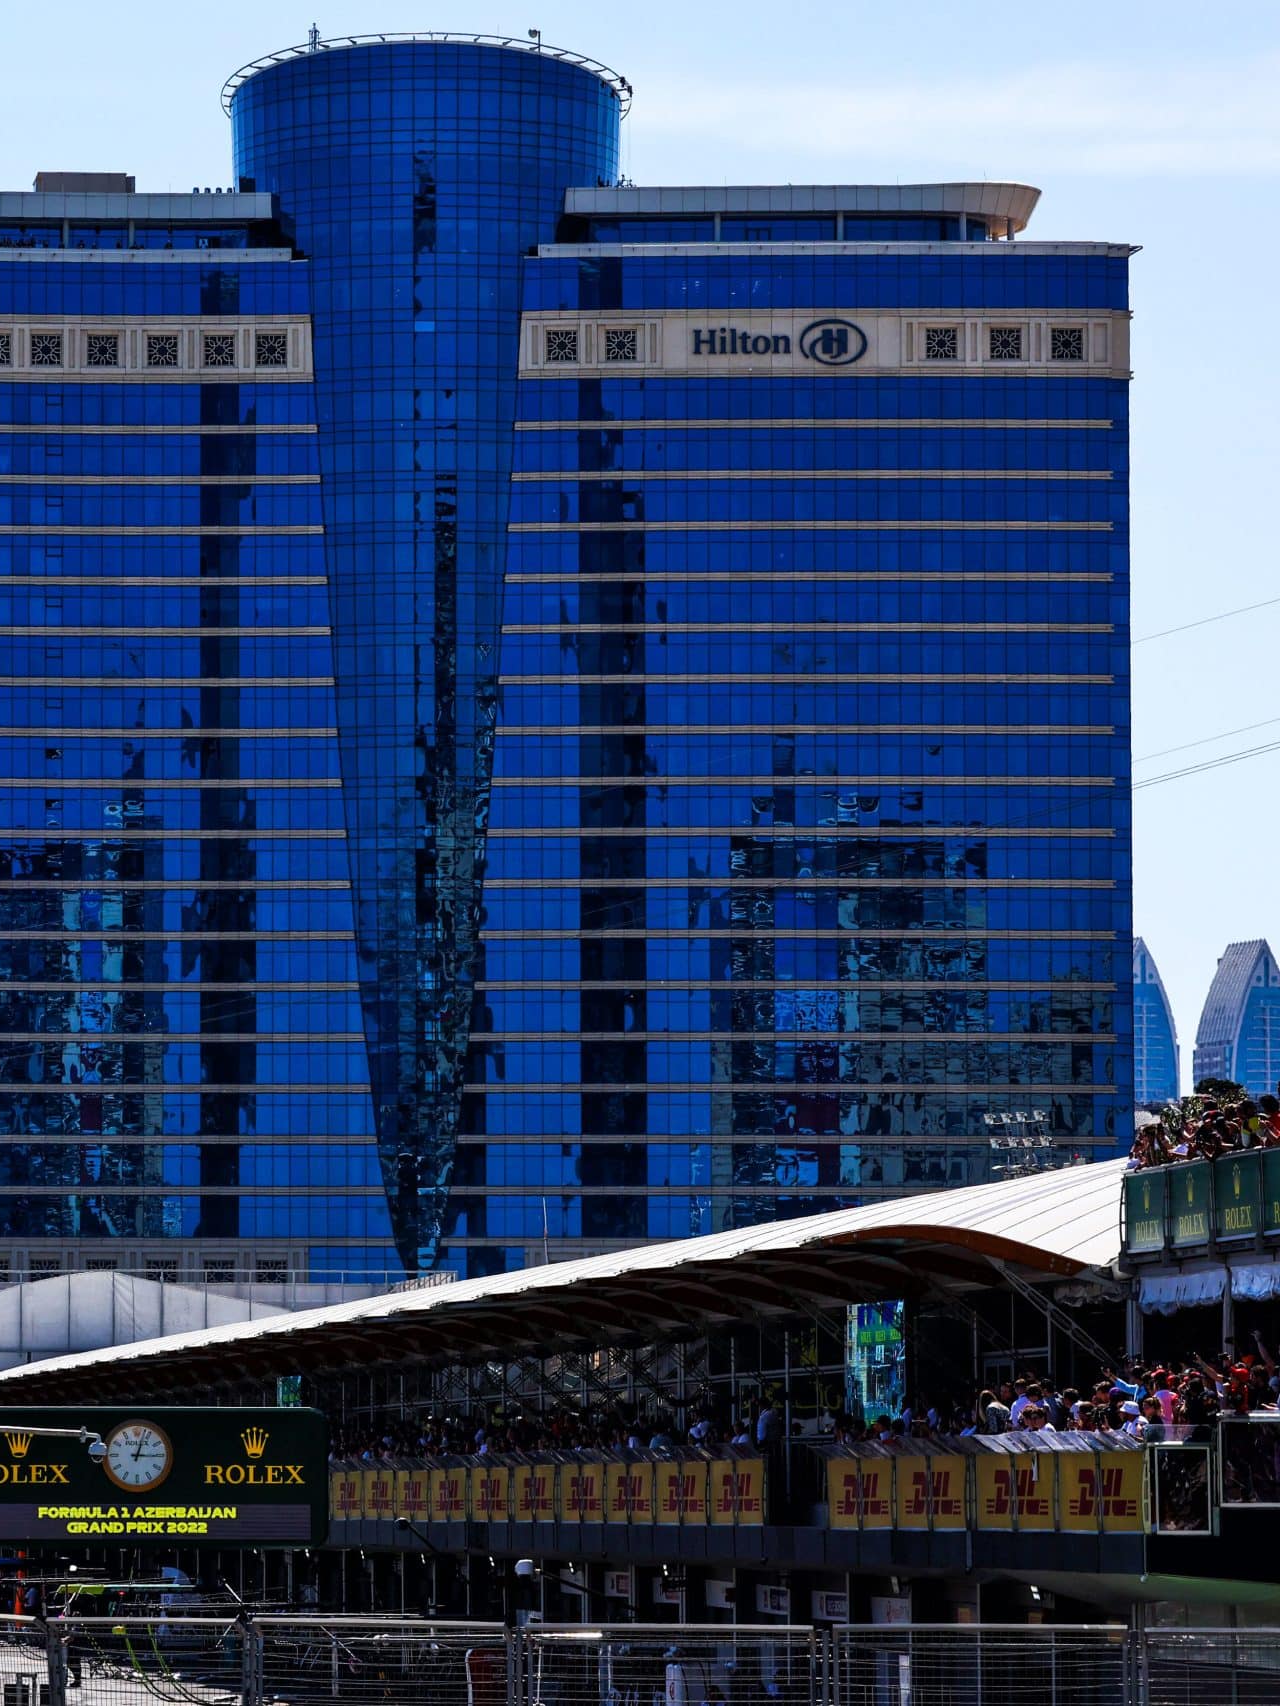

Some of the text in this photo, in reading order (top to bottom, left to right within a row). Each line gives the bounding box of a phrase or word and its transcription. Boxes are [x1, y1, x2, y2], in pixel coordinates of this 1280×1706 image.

[693, 327, 791, 354] Hilton
[1179, 1213, 1205, 1237] ROLEX
[1225, 1206, 1252, 1230] ROLEX
[1135, 1219, 1160, 1242] ROLEX
[204, 1465, 305, 1485] ROLEX
[843, 1473, 882, 1515] DHL
[912, 1471, 954, 1514] DHL
[994, 1469, 1040, 1514] DHL
[1077, 1468, 1128, 1516] DHL
[38, 1506, 236, 1519] FORMULA 1 AZERBAIJAN
[66, 1521, 208, 1534] GRAND PRIX 2022
